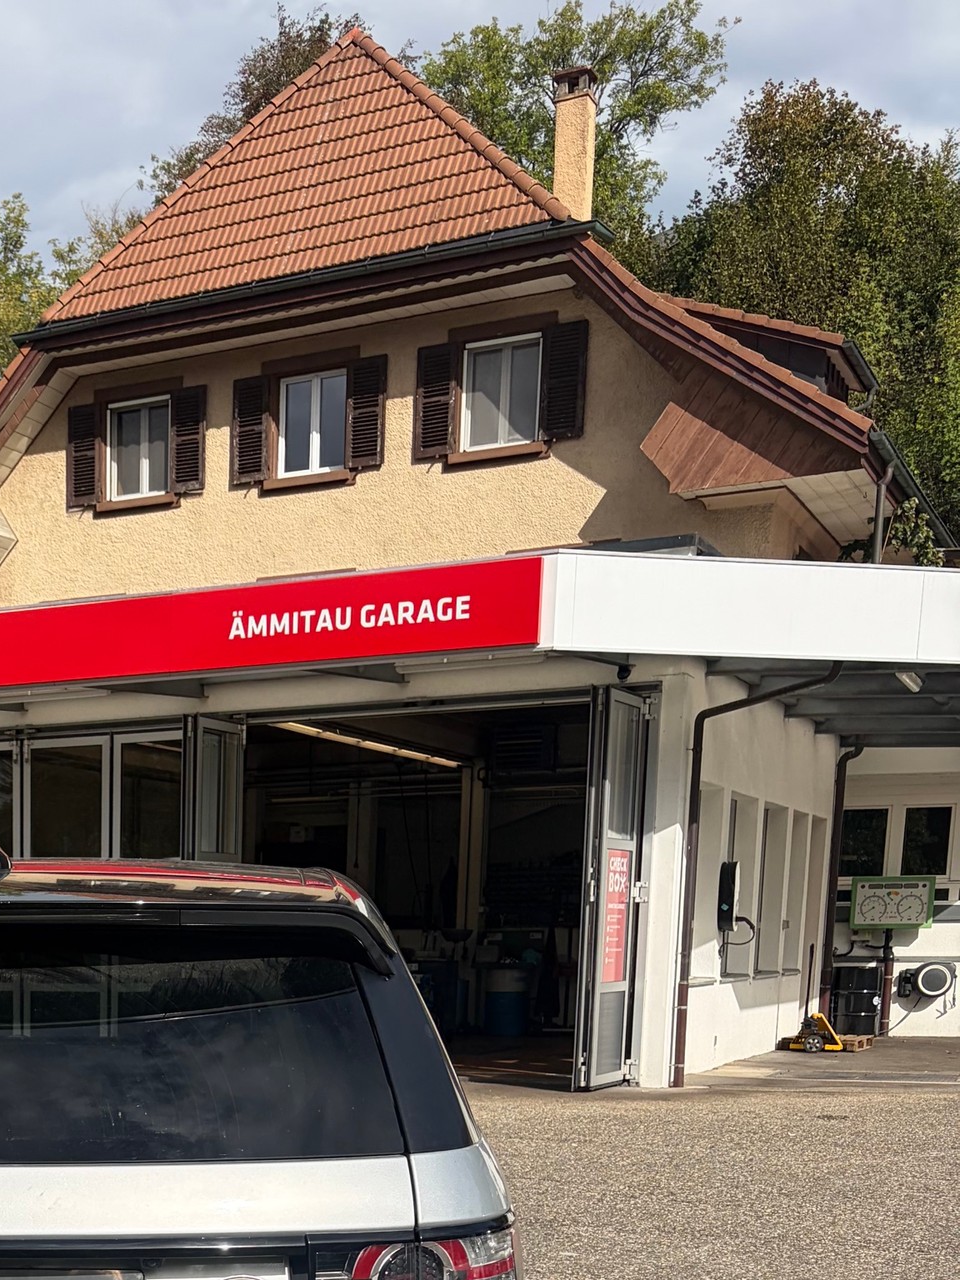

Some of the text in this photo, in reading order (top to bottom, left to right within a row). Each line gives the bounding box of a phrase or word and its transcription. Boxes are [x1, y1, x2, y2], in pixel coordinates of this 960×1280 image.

[228, 595, 471, 640] ÄMMITAU GARAGE
[608, 871, 627, 893] BOX
